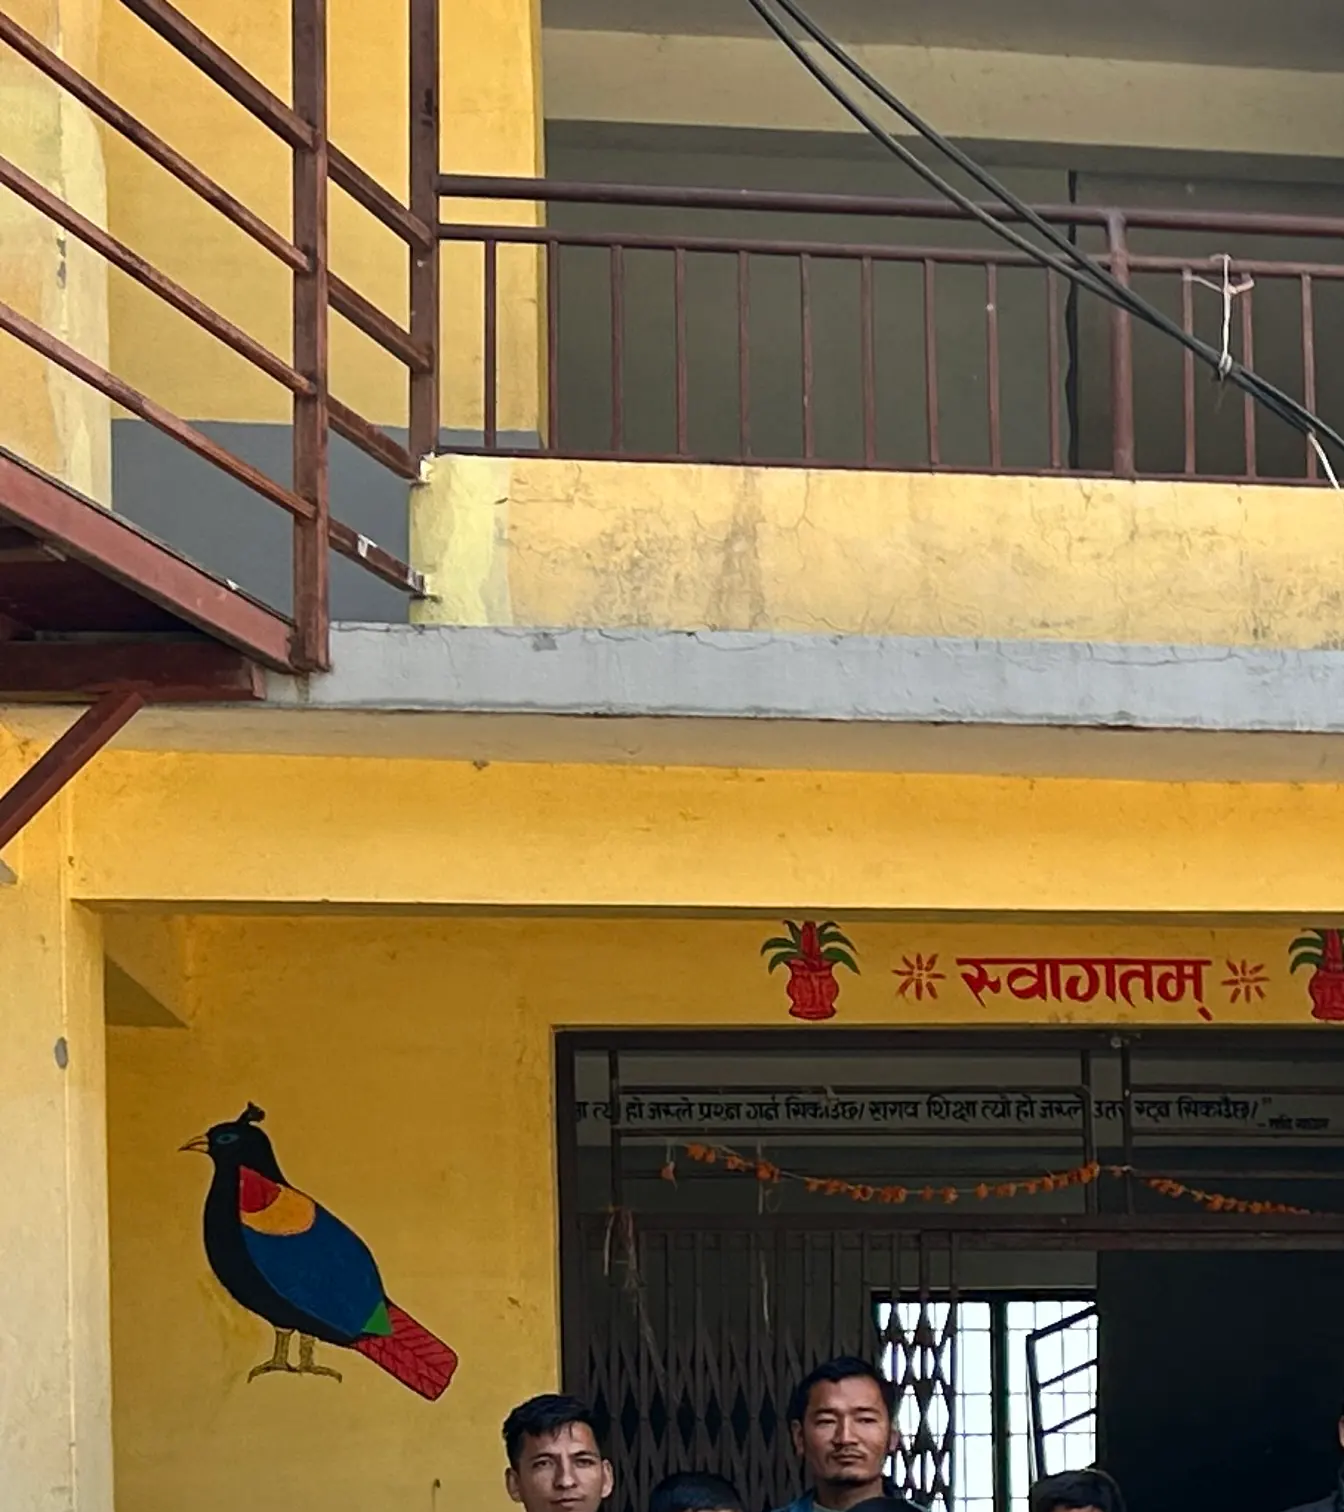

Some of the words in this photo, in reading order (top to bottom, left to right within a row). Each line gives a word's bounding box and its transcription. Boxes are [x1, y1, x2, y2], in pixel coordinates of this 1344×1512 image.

[956, 957, 1213, 1022] स्वागतम्
[626, 1096, 647, 1123] हो
[927, 1094, 979, 1123] शिक्षा
[980, 1095, 1013, 1121] त्यो
[1014, 1094, 1038, 1124] हो
